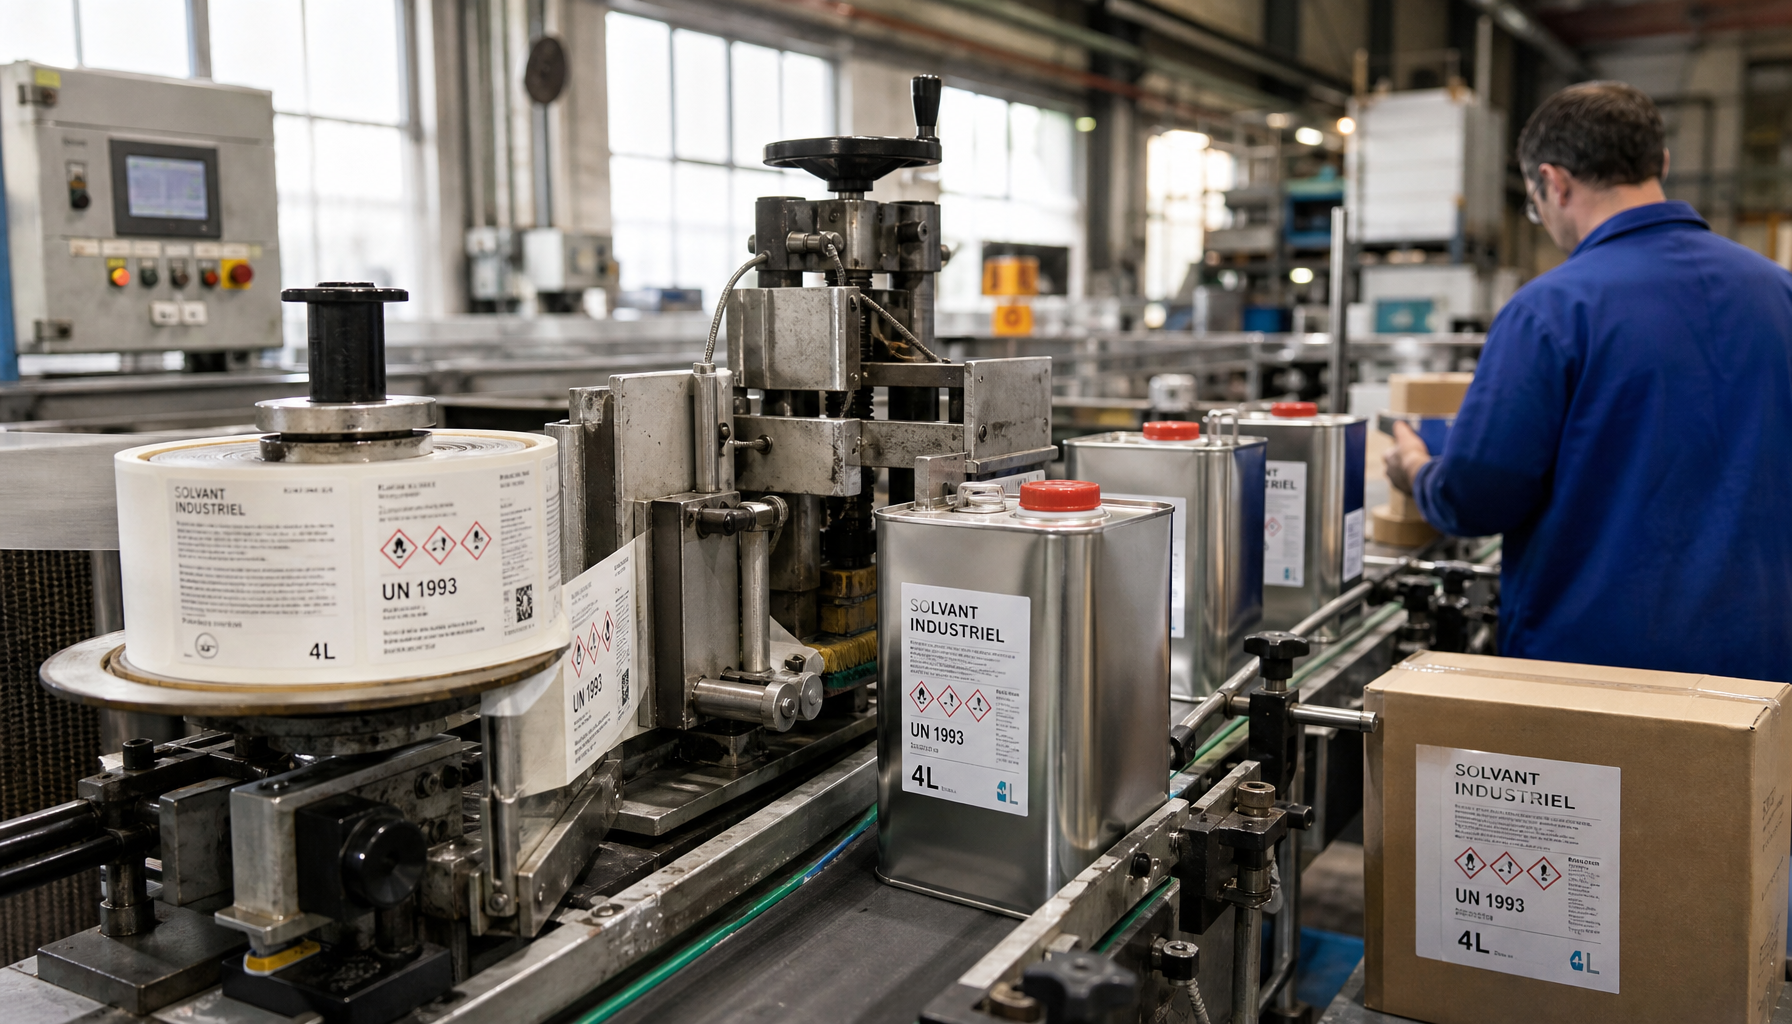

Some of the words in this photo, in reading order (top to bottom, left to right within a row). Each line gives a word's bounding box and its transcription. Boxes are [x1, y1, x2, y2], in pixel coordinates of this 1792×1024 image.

[175, 486, 226, 500] SOLVANT
[175, 501, 246, 516] INDUSTRIEL
[382, 581, 410, 601] UN
[416, 577, 458, 598] 1993
[910, 598, 979, 620] SOLVANT
[910, 617, 1005, 643] INDUSTRIEL
[308, 642, 336, 660] 4L
[572, 686, 586, 713] UN
[586, 673, 603, 703] 1993
[910, 721, 930, 740] UN
[933, 726, 964, 745] 1993
[911, 764, 939, 791] 4L
[1455, 763, 1540, 786] SOLVANT
[1455, 781, 1576, 810] INDUSTRIEL
[1455, 887, 1480, 906] UN
[1485, 893, 1525, 913] 1993
[1457, 929, 1490, 954] 4L
